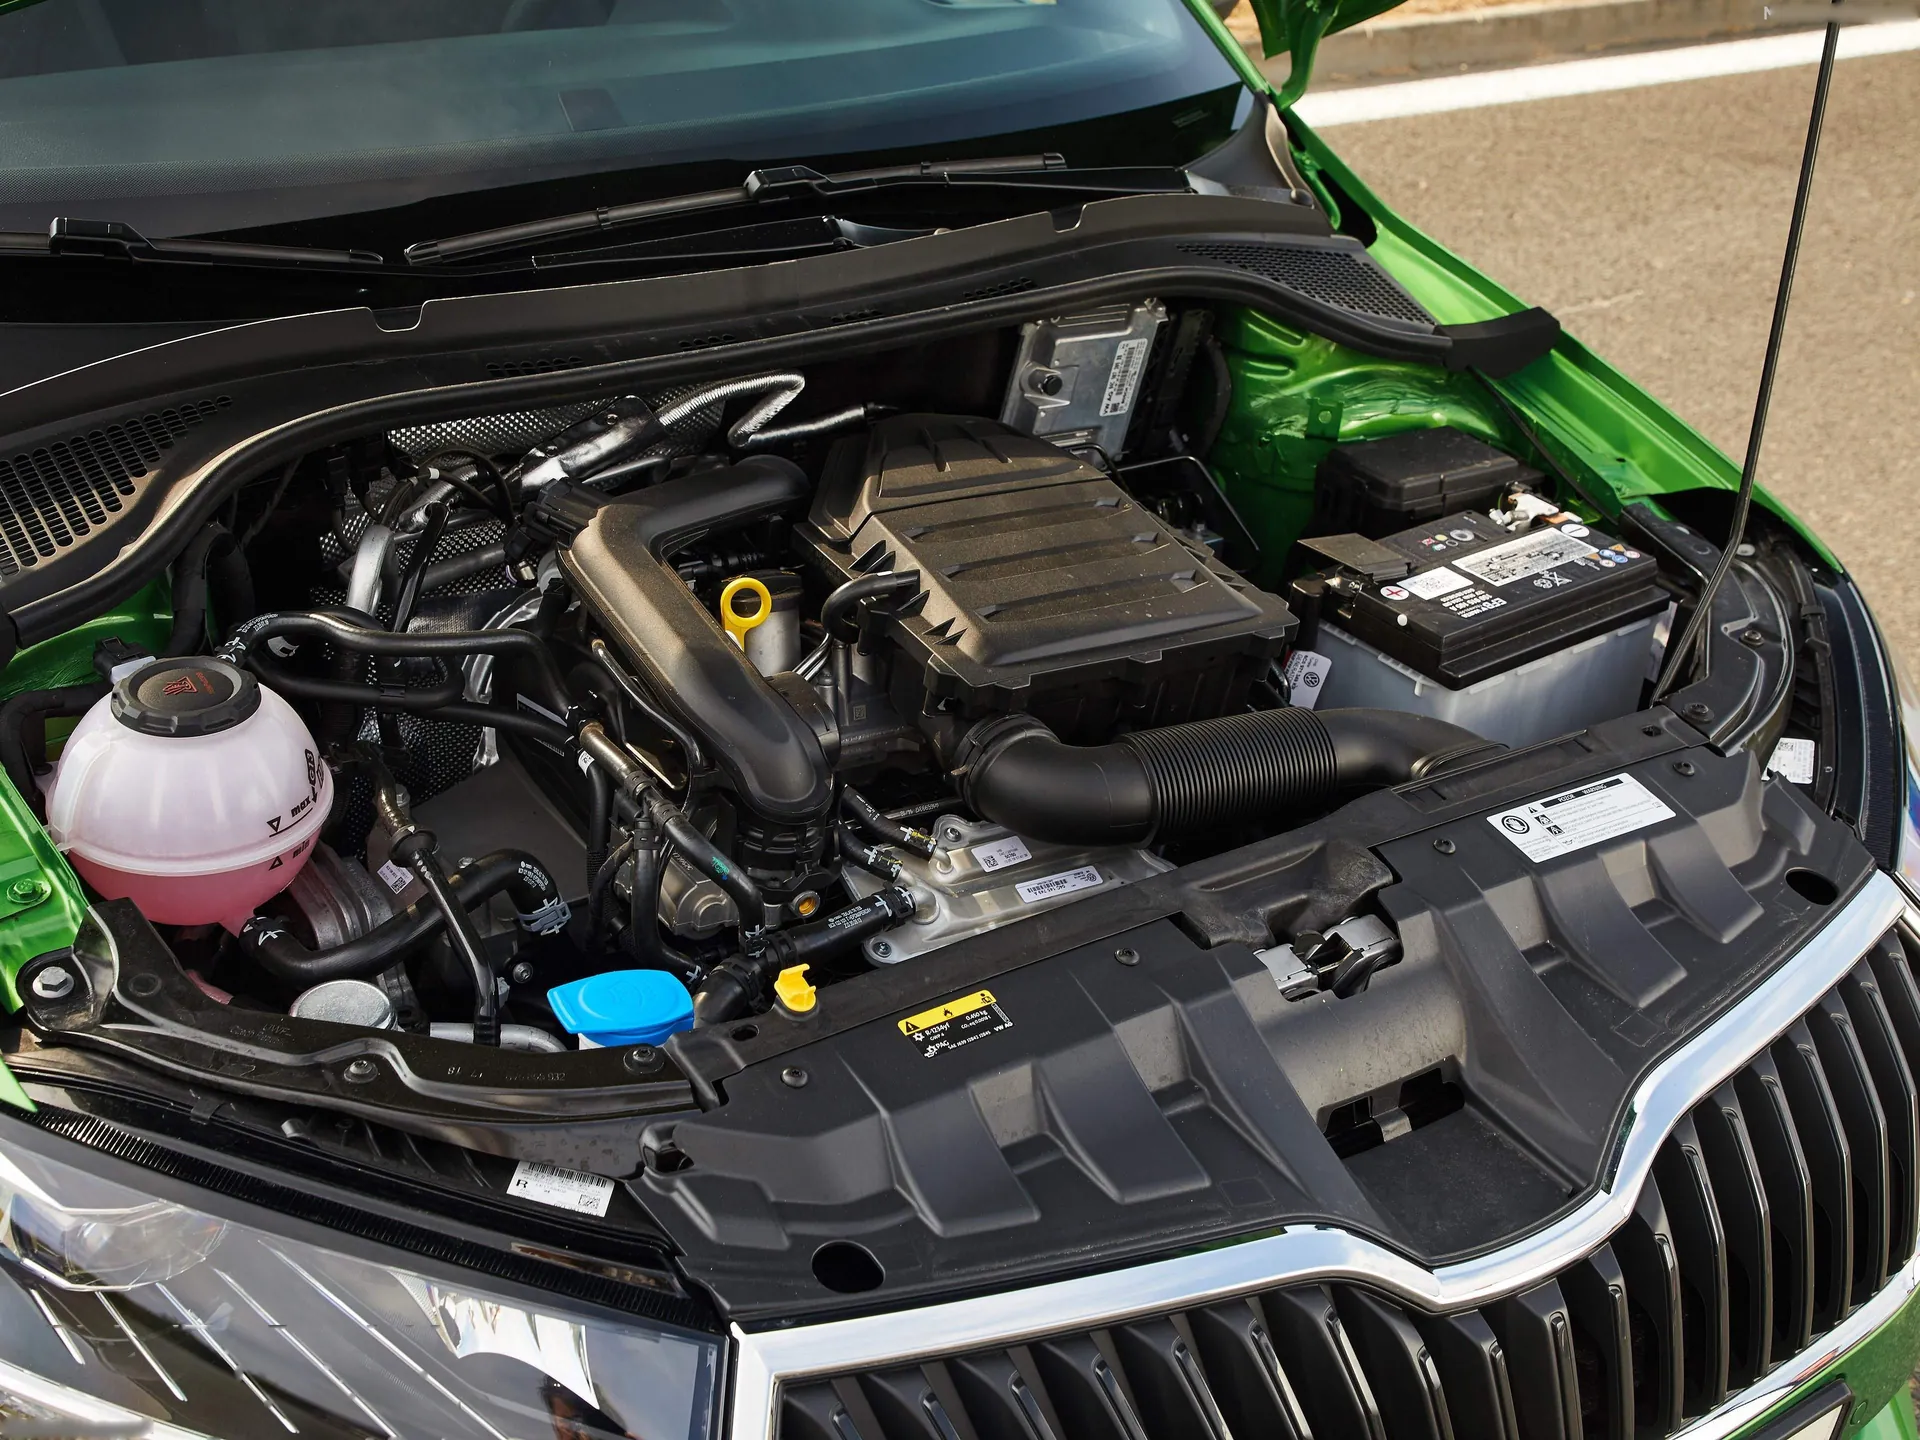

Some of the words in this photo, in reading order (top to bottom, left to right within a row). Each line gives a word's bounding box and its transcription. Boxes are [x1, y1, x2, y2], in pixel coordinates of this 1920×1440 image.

[1482, 597, 1508, 610] EFB
[290, 795, 311, 818] max
[293, 840, 310, 859] min
[993, 1025, 1004, 1033] VW
[935, 1039, 950, 1050] PAG
[516, 1179, 529, 1188] R
